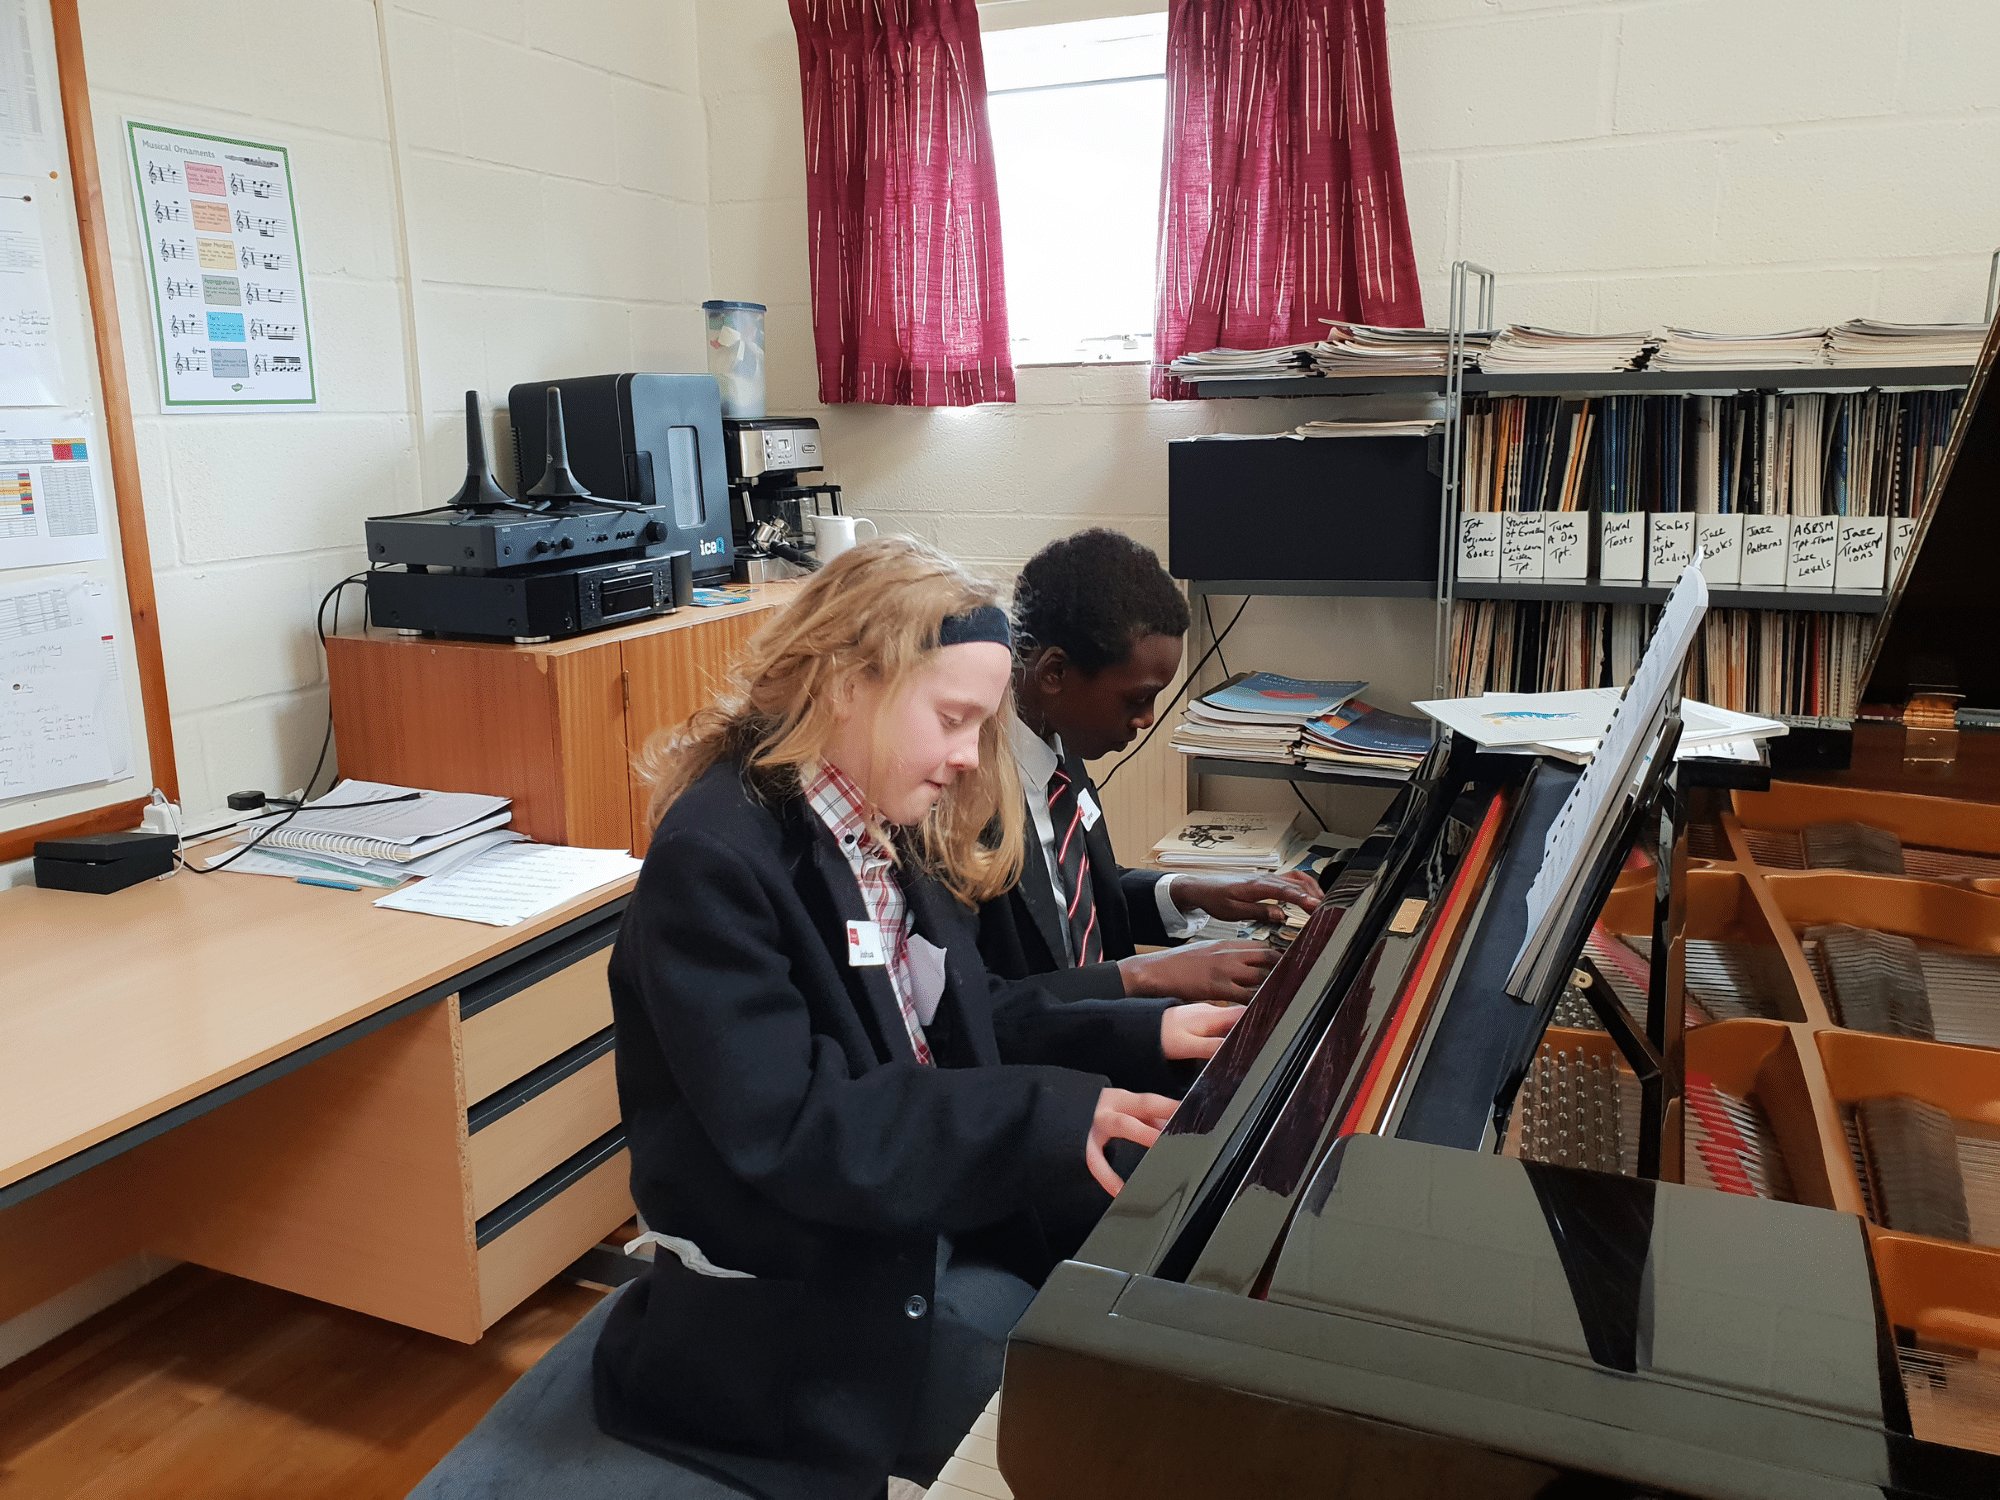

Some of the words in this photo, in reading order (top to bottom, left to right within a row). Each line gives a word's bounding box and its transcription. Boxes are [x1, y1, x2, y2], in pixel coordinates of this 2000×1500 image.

[142, 139, 172, 152] Musical
[174, 144, 216, 158] Ornaments
[1505, 514, 1542, 528] Standard
[1603, 519, 1630, 536] Aural
[1654, 520, 1690, 531] Scales
[1700, 528, 1726, 542] Jazz
[1746, 525, 1774, 538] Jazz
[1793, 521, 1834, 537] ABRSM
[1842, 527, 1876, 541] Jazz
[1547, 536, 1555, 545] A
[1560, 531, 1578, 546] Day
[1604, 535, 1634, 549] Tests
[700, 536, 726, 556] iceQ
[1466, 547, 1494, 559] Books
[1702, 538, 1733, 559] Books
[1746, 538, 1783, 556] Patterns
[1792, 554, 1817, 564] Jazz
[1798, 557, 1832, 577] Levels
